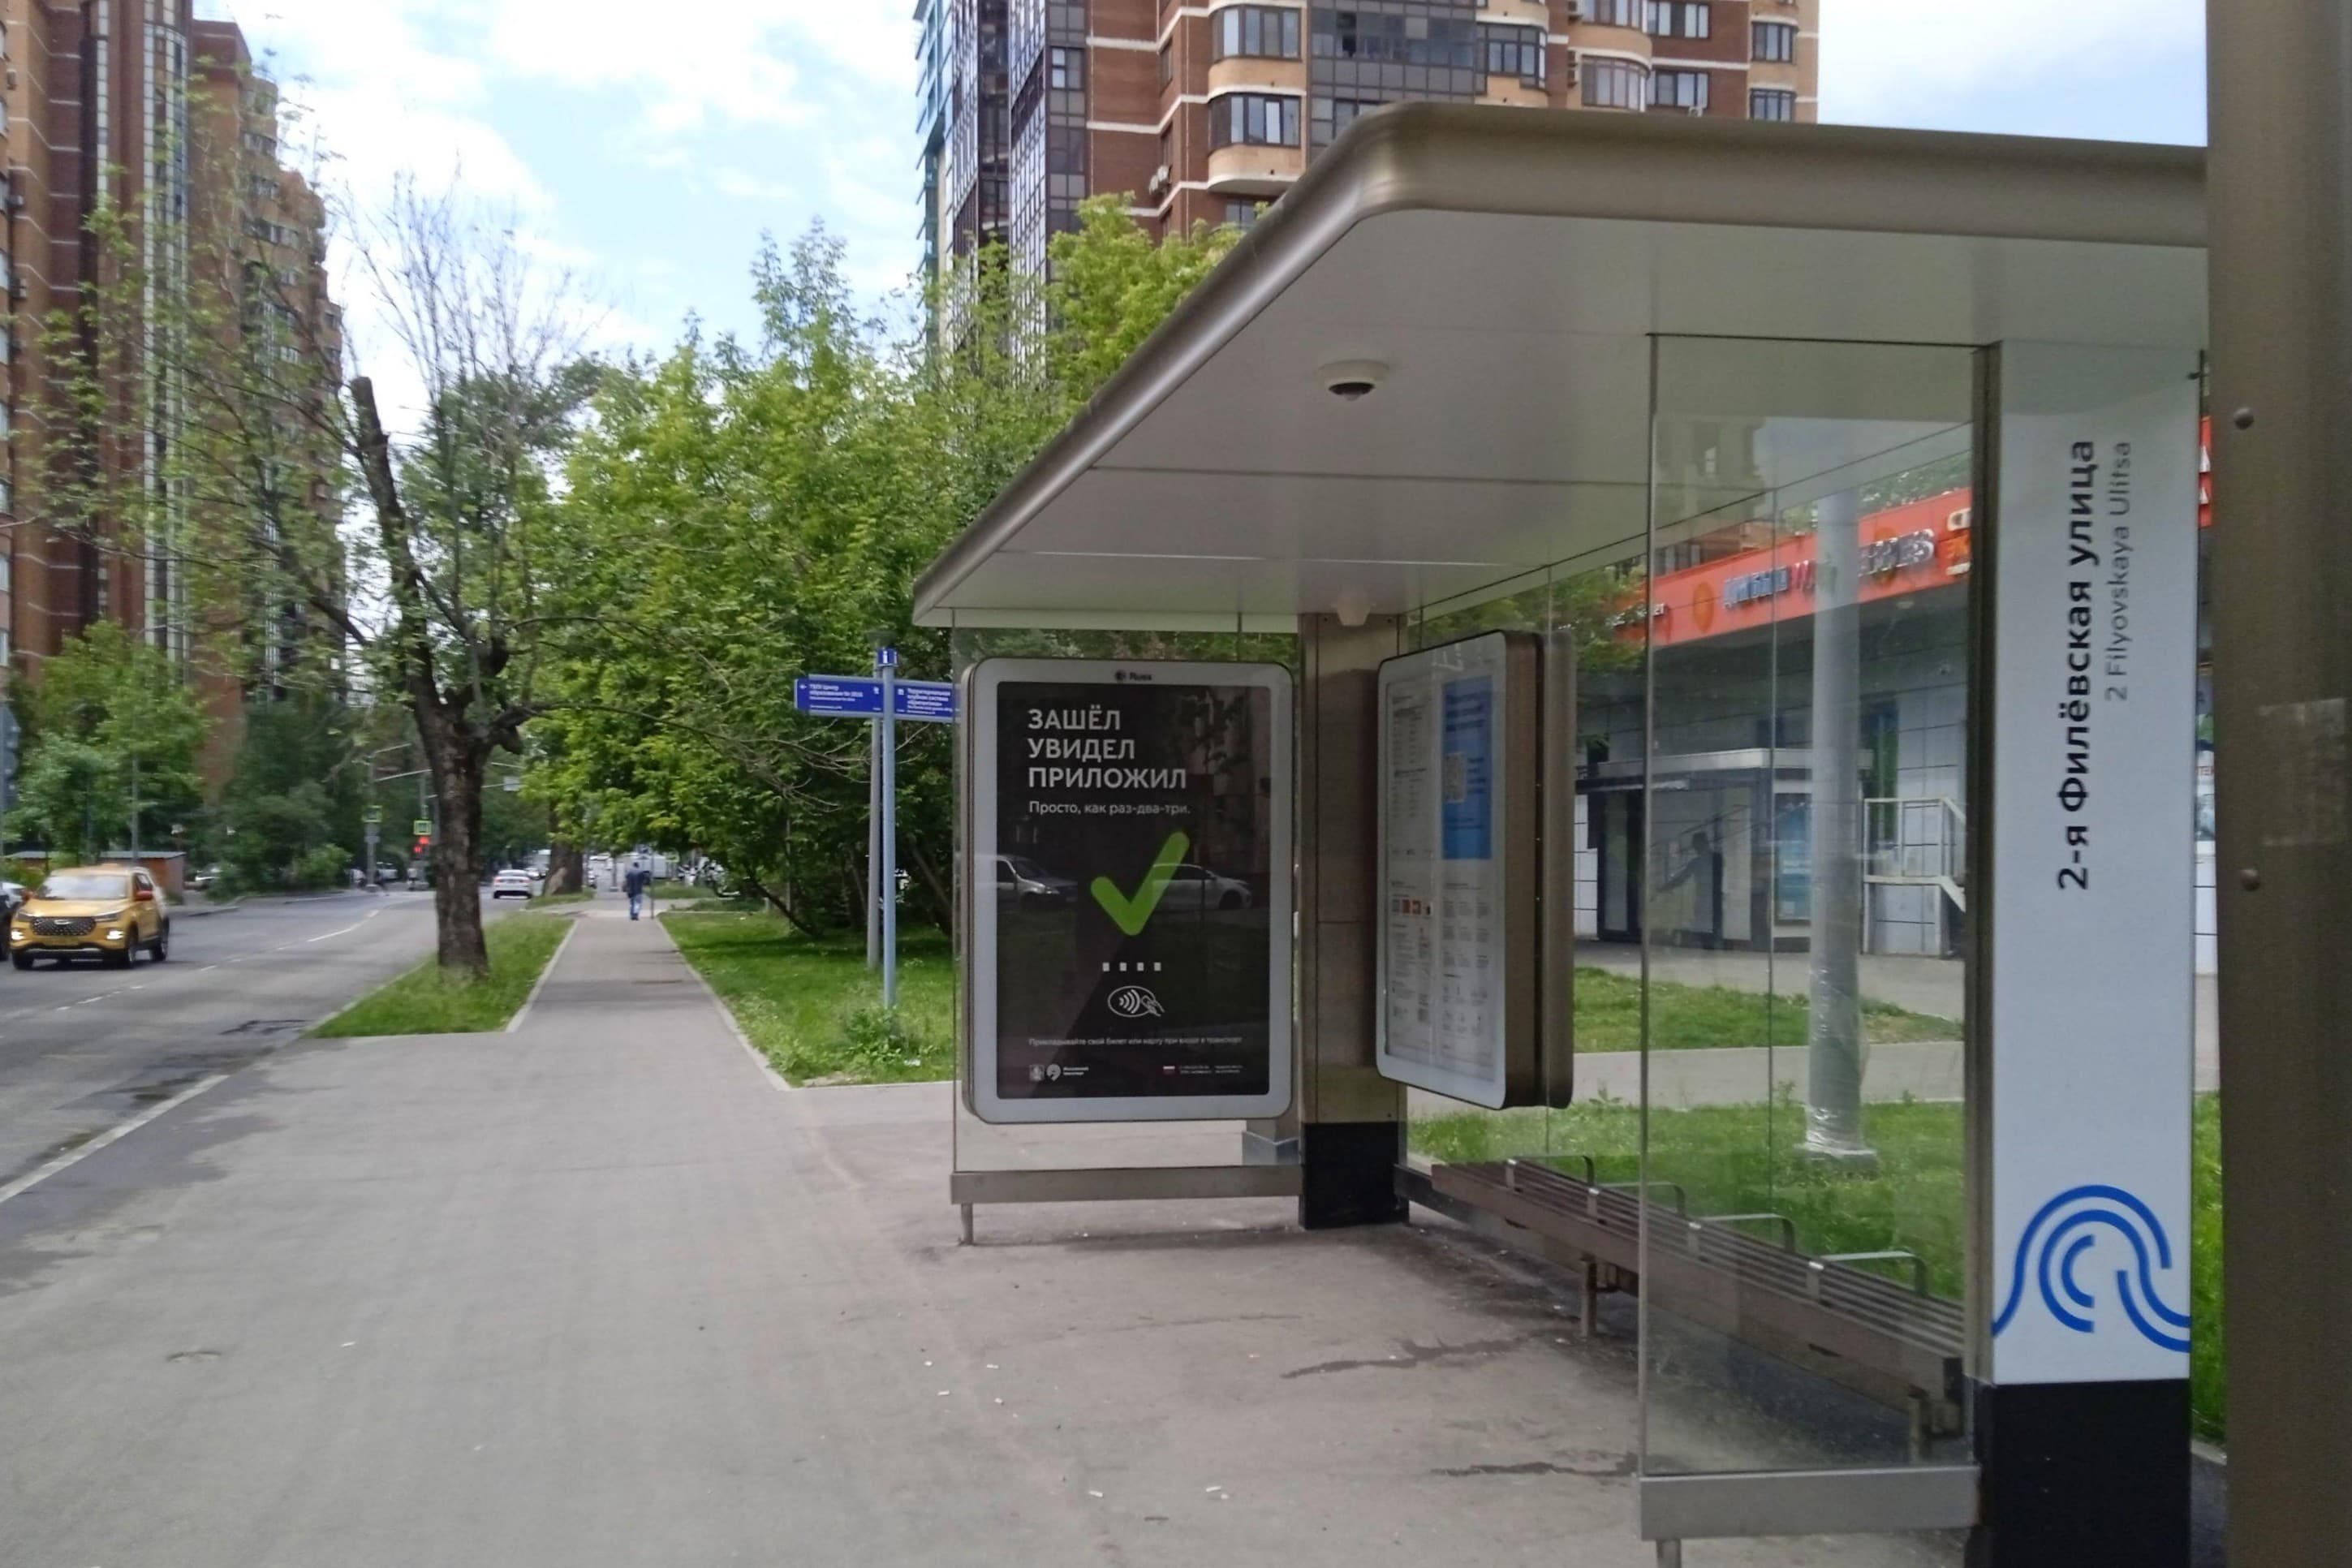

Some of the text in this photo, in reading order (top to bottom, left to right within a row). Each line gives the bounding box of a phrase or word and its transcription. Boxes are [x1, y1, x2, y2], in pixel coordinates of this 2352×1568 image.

[2105, 442, 2133, 701] 2 Filyovskaya Ulitsa
[2057, 442, 2100, 890] 2-я Филёвская улица
[1027, 704, 1120, 730] ЗАШЁЛ
[1027, 738, 1135, 762] УВИДЕЛ
[1029, 767, 1187, 789] ПРИЛОЖИЛ
[1029, 800, 1191, 816] Просто, как раз-два-три.
